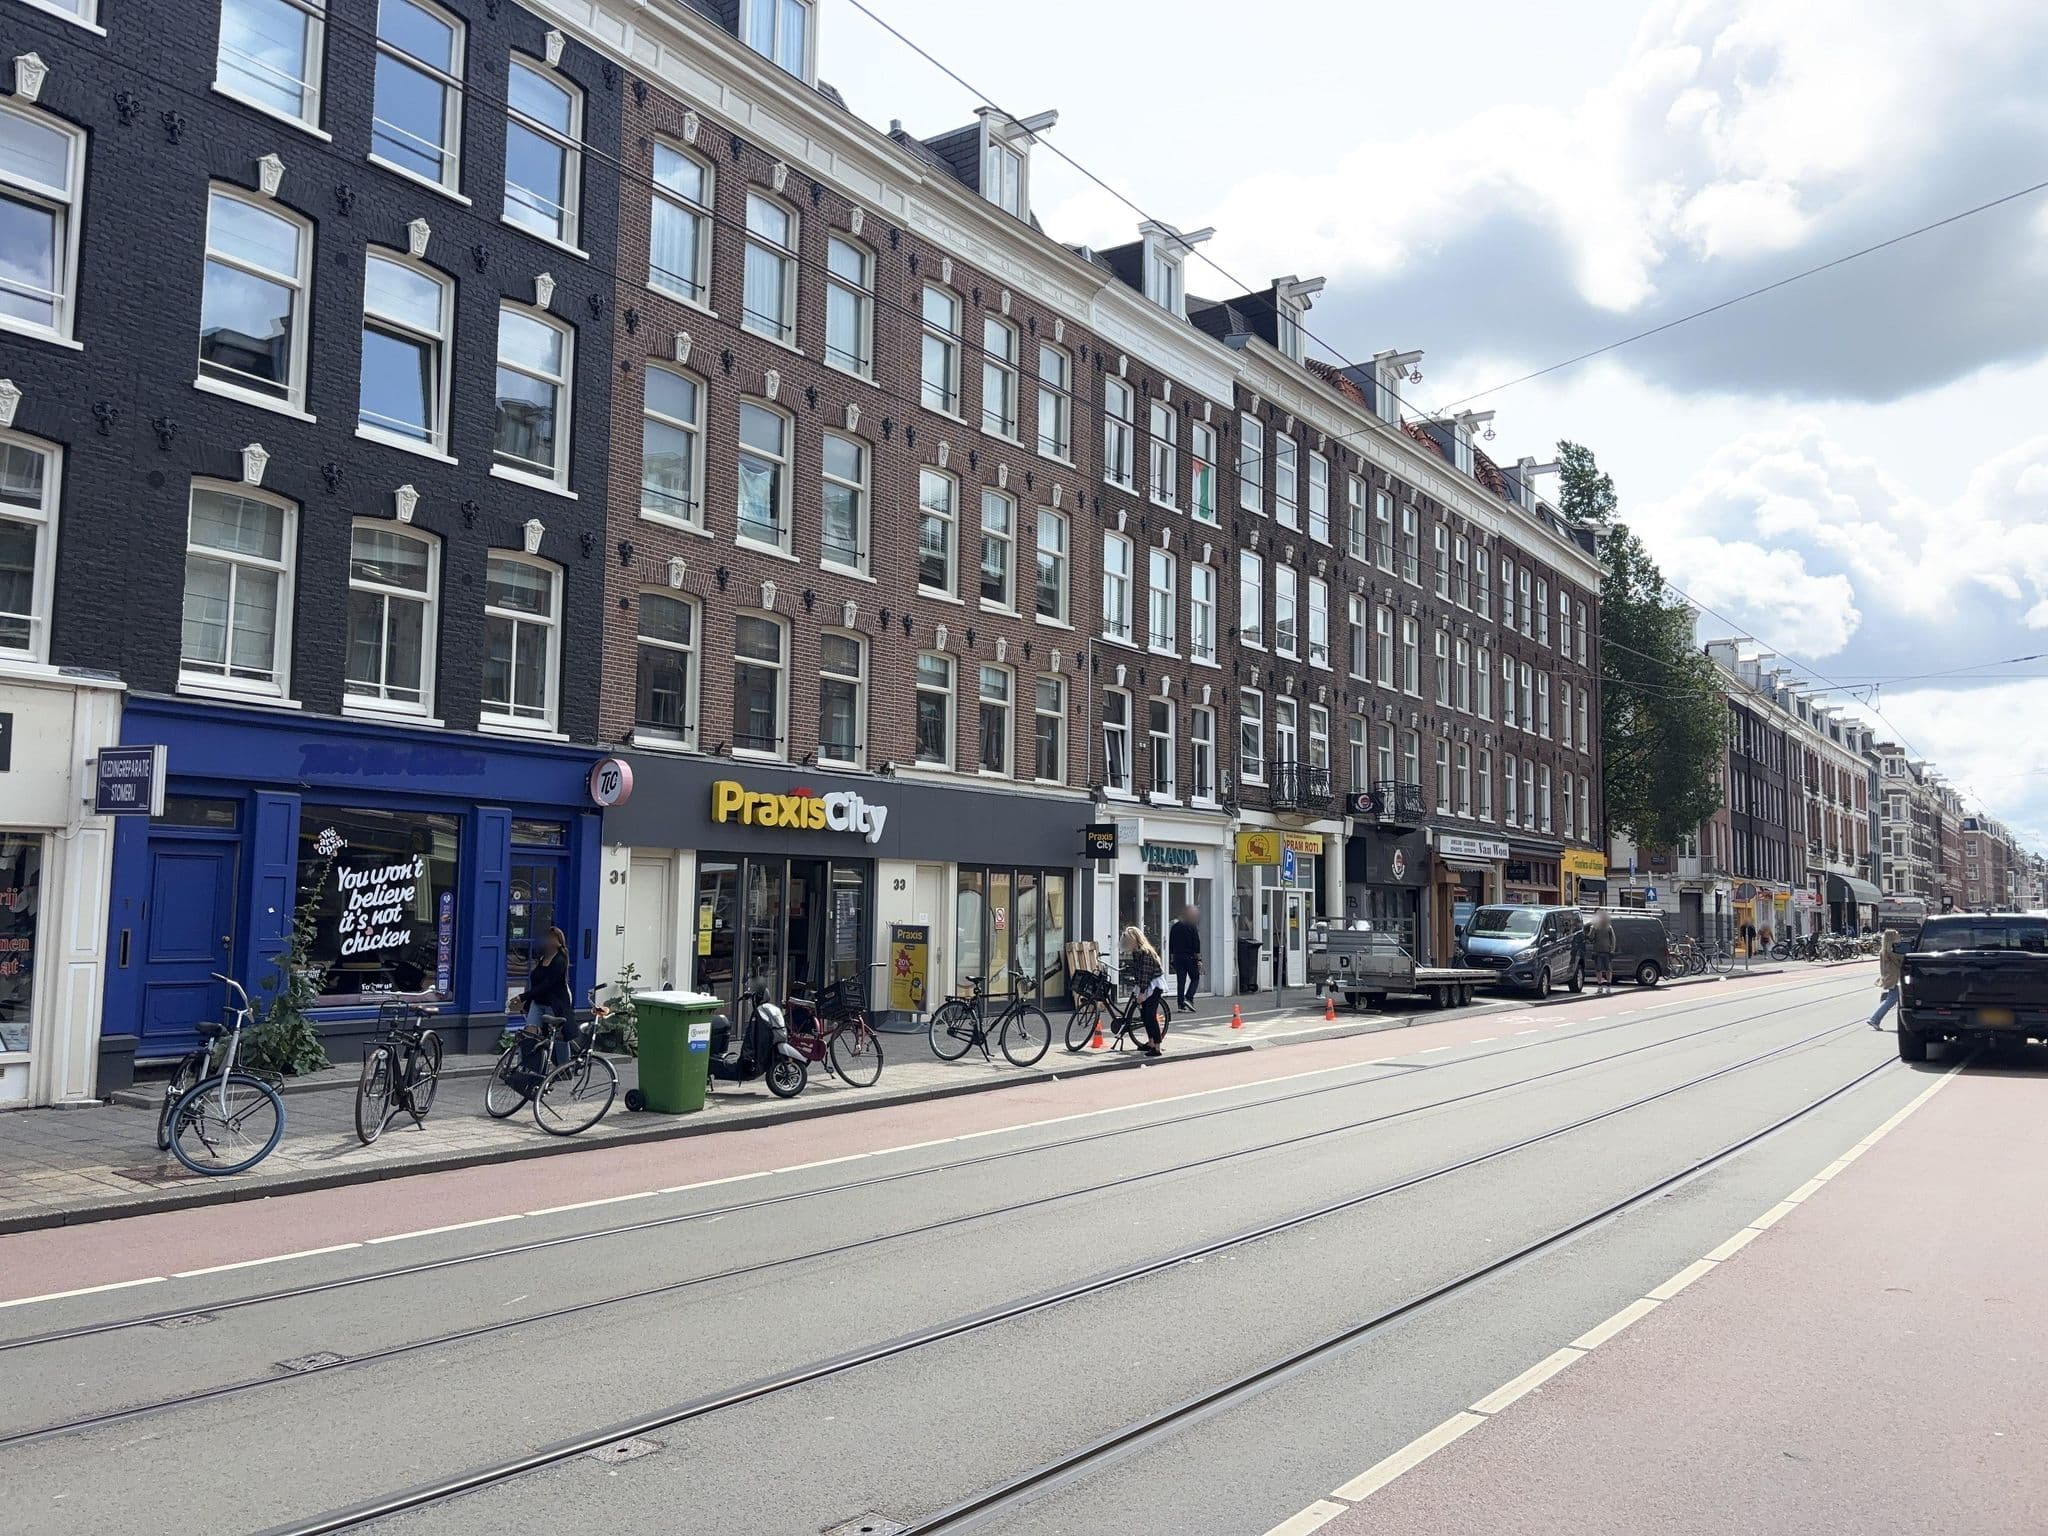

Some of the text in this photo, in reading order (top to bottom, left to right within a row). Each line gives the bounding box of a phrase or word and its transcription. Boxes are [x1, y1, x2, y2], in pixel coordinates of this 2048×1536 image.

[101, 759, 149, 778] KLEDINGREPARATIE
[601, 771, 618, 795] TLC
[111, 784, 136, 801] STOMERIJ
[320, 827, 337, 839] We
[1088, 832, 1113, 841] Praxis
[1096, 840, 1113, 851] City
[1304, 841, 1319, 853] ROTI
[1478, 842, 1491, 855] Van
[1140, 843, 1199, 866] VERANDA
[1286, 851, 1293, 867] P
[338, 853, 424, 892] You won't
[609, 870, 626, 884] 31
[893, 879, 906, 890] 33
[348, 884, 416, 910] believe
[339, 904, 403, 933] it's not
[341, 927, 411, 956] chicken
[897, 929, 923, 940] Praxis
[1339, 956, 1350, 968] D
